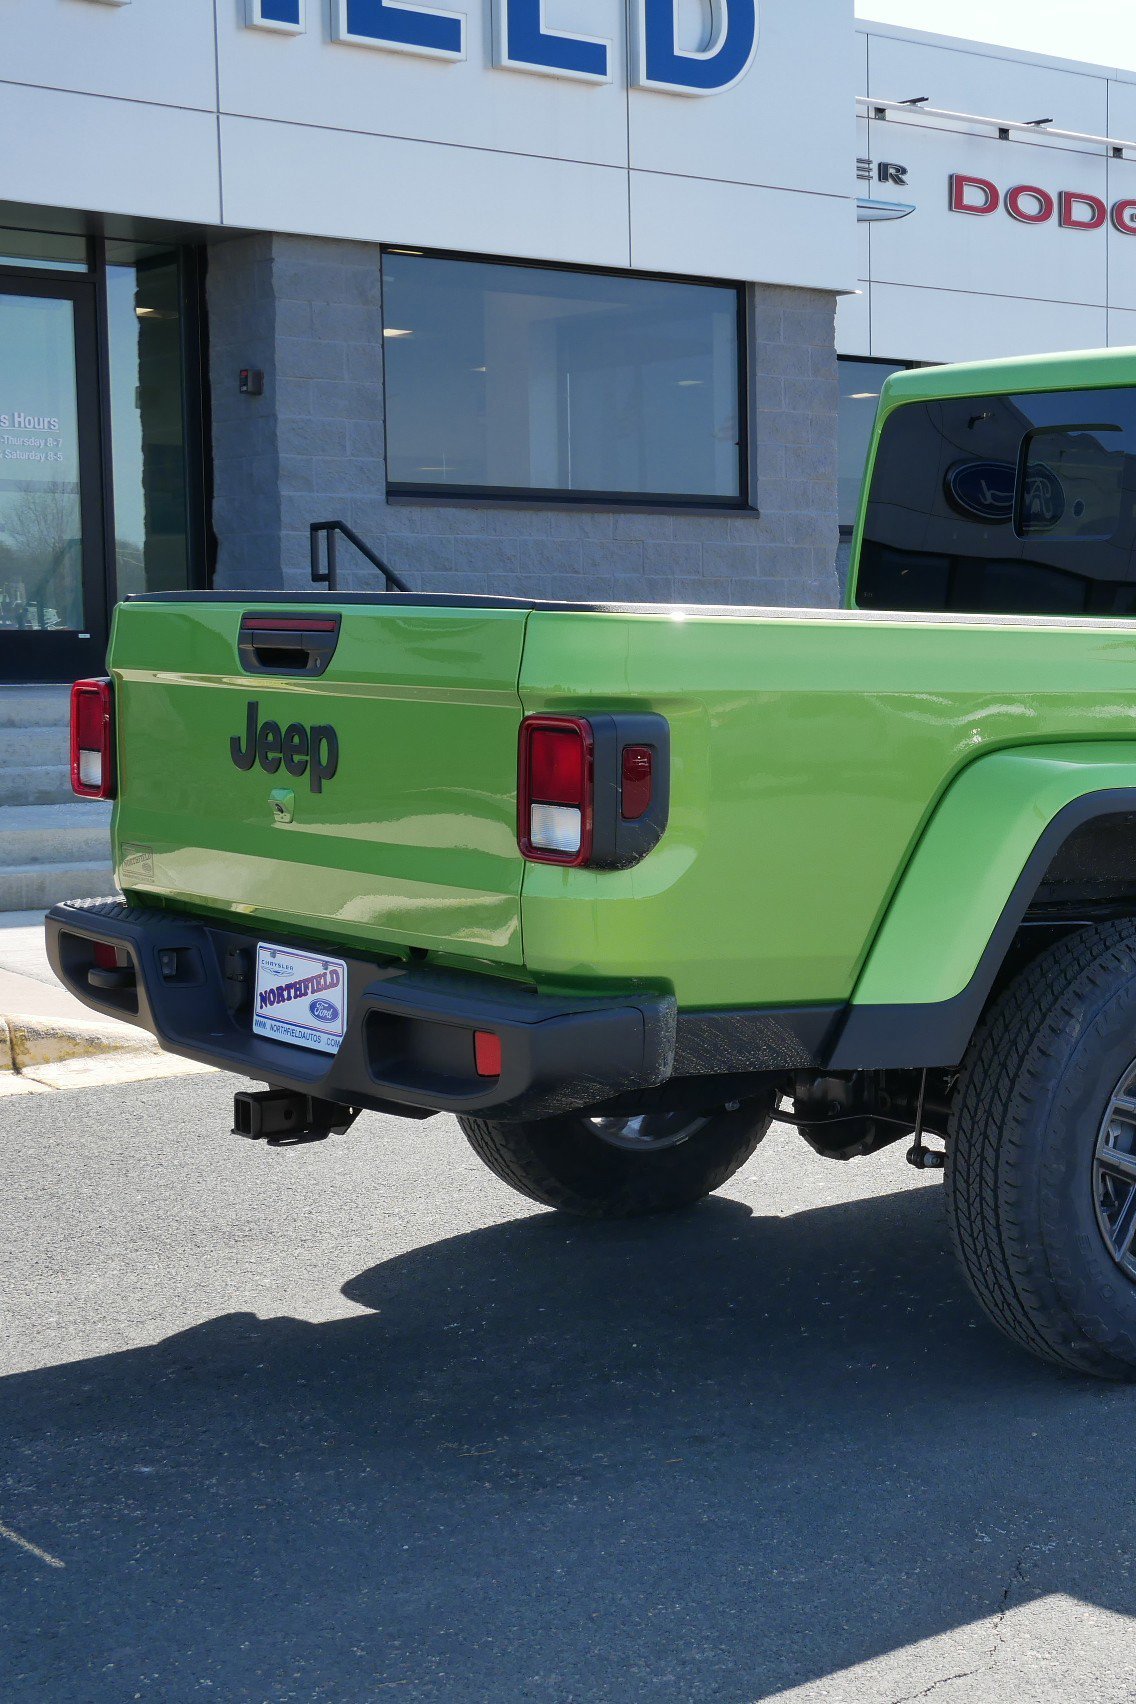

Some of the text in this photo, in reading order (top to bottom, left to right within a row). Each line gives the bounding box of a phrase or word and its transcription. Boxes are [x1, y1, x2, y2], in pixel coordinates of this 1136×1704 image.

[14, 412, 59, 430] Hours
[47, 438, 63, 447] 8-7
[5, 450, 63, 462] Saturday 8-5
[229, 700, 339, 794] Jeep
[259, 968, 340, 1010] NORTHFIELD
[314, 1001, 334, 1019] Ford
[269, 1023, 322, 1044] NORTHFIELDAUTOS
